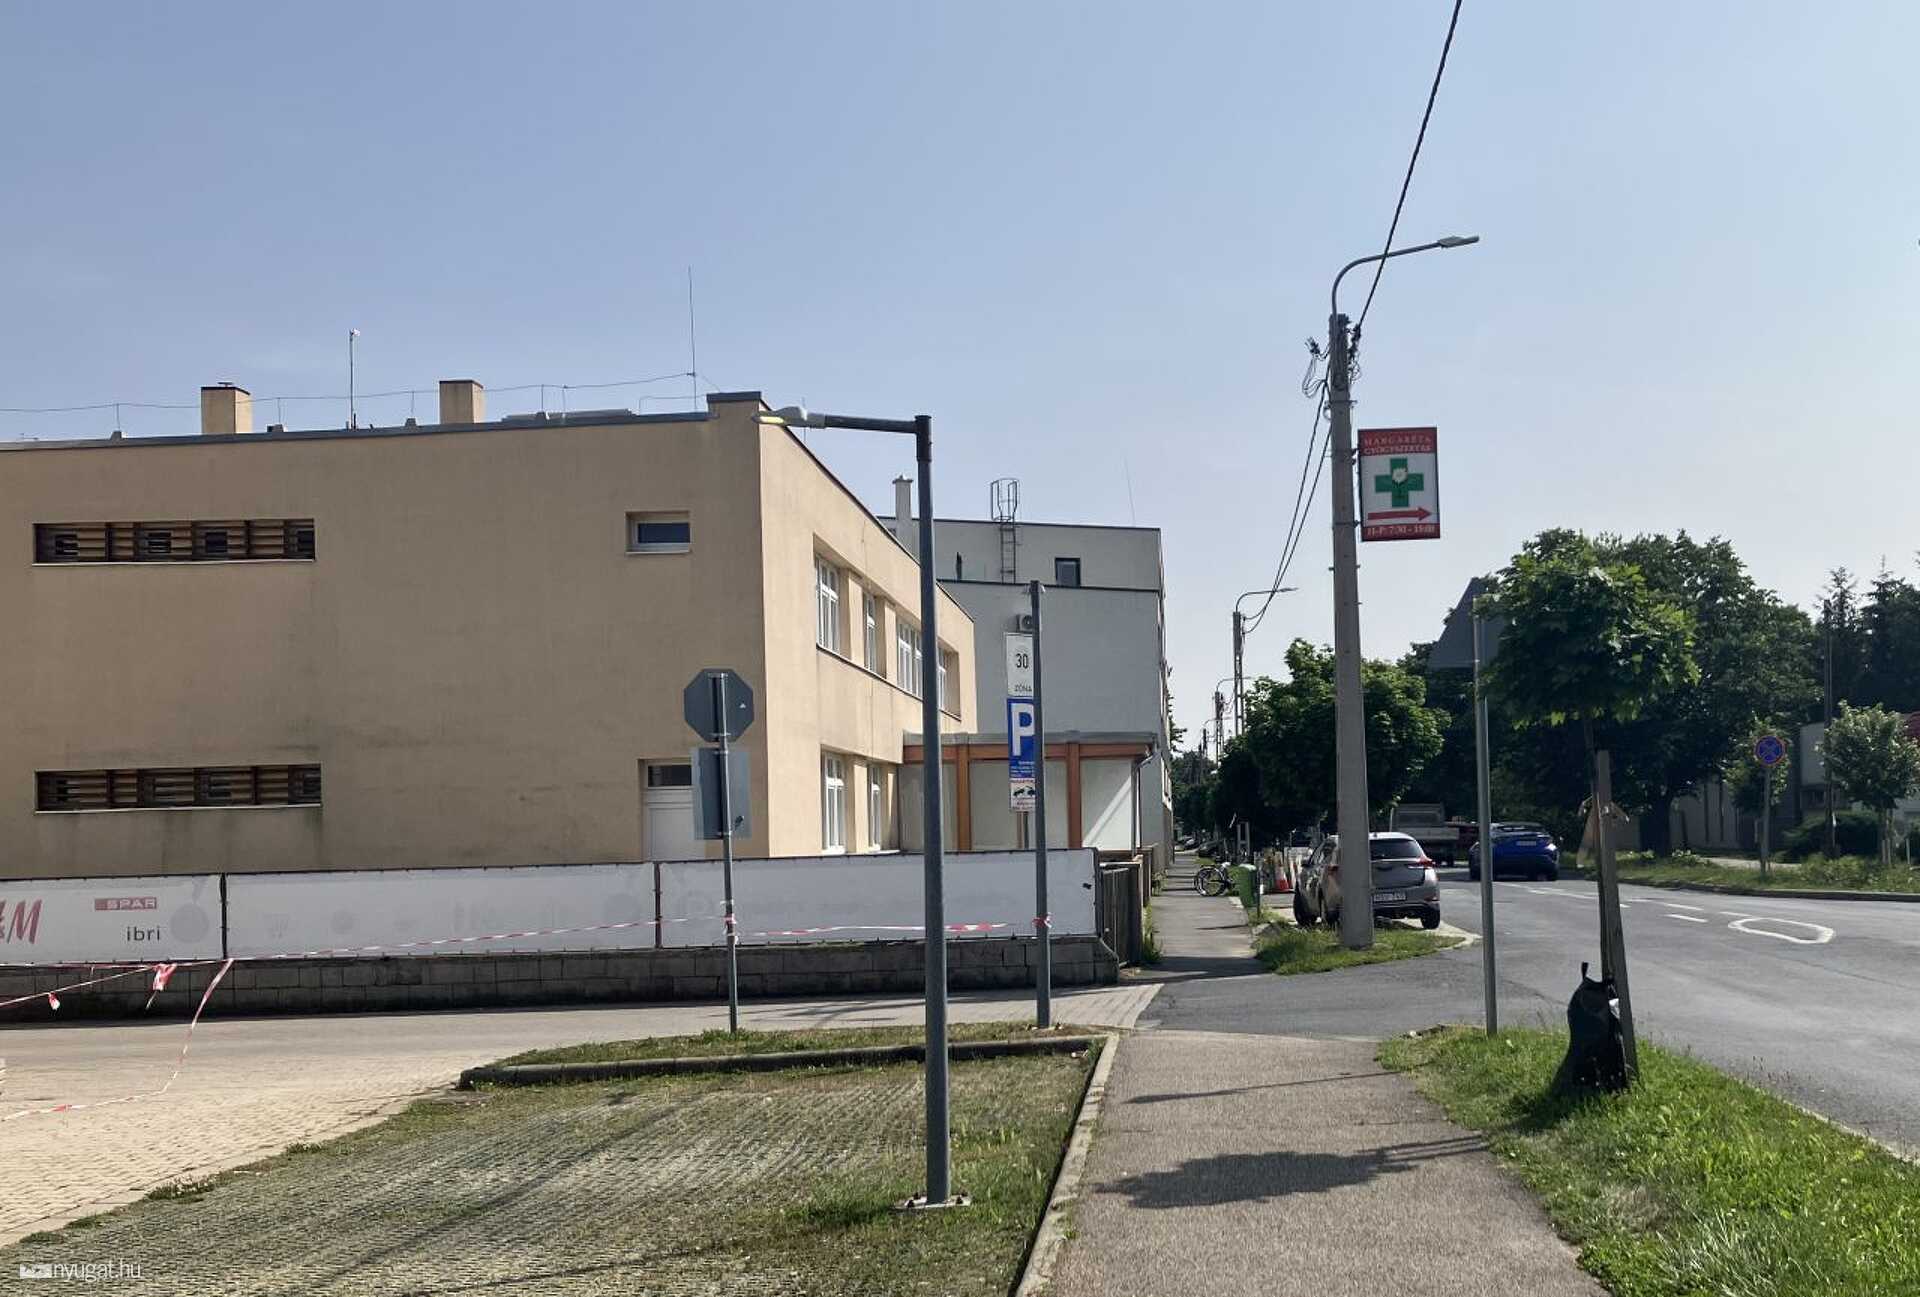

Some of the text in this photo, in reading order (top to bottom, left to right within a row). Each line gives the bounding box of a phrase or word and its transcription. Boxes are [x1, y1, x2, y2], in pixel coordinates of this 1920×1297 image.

[1016, 653, 1029, 669] 30
[1010, 702, 1035, 756] P
[106, 899, 157, 910] SPAR
[126, 925, 161, 942] ibri
